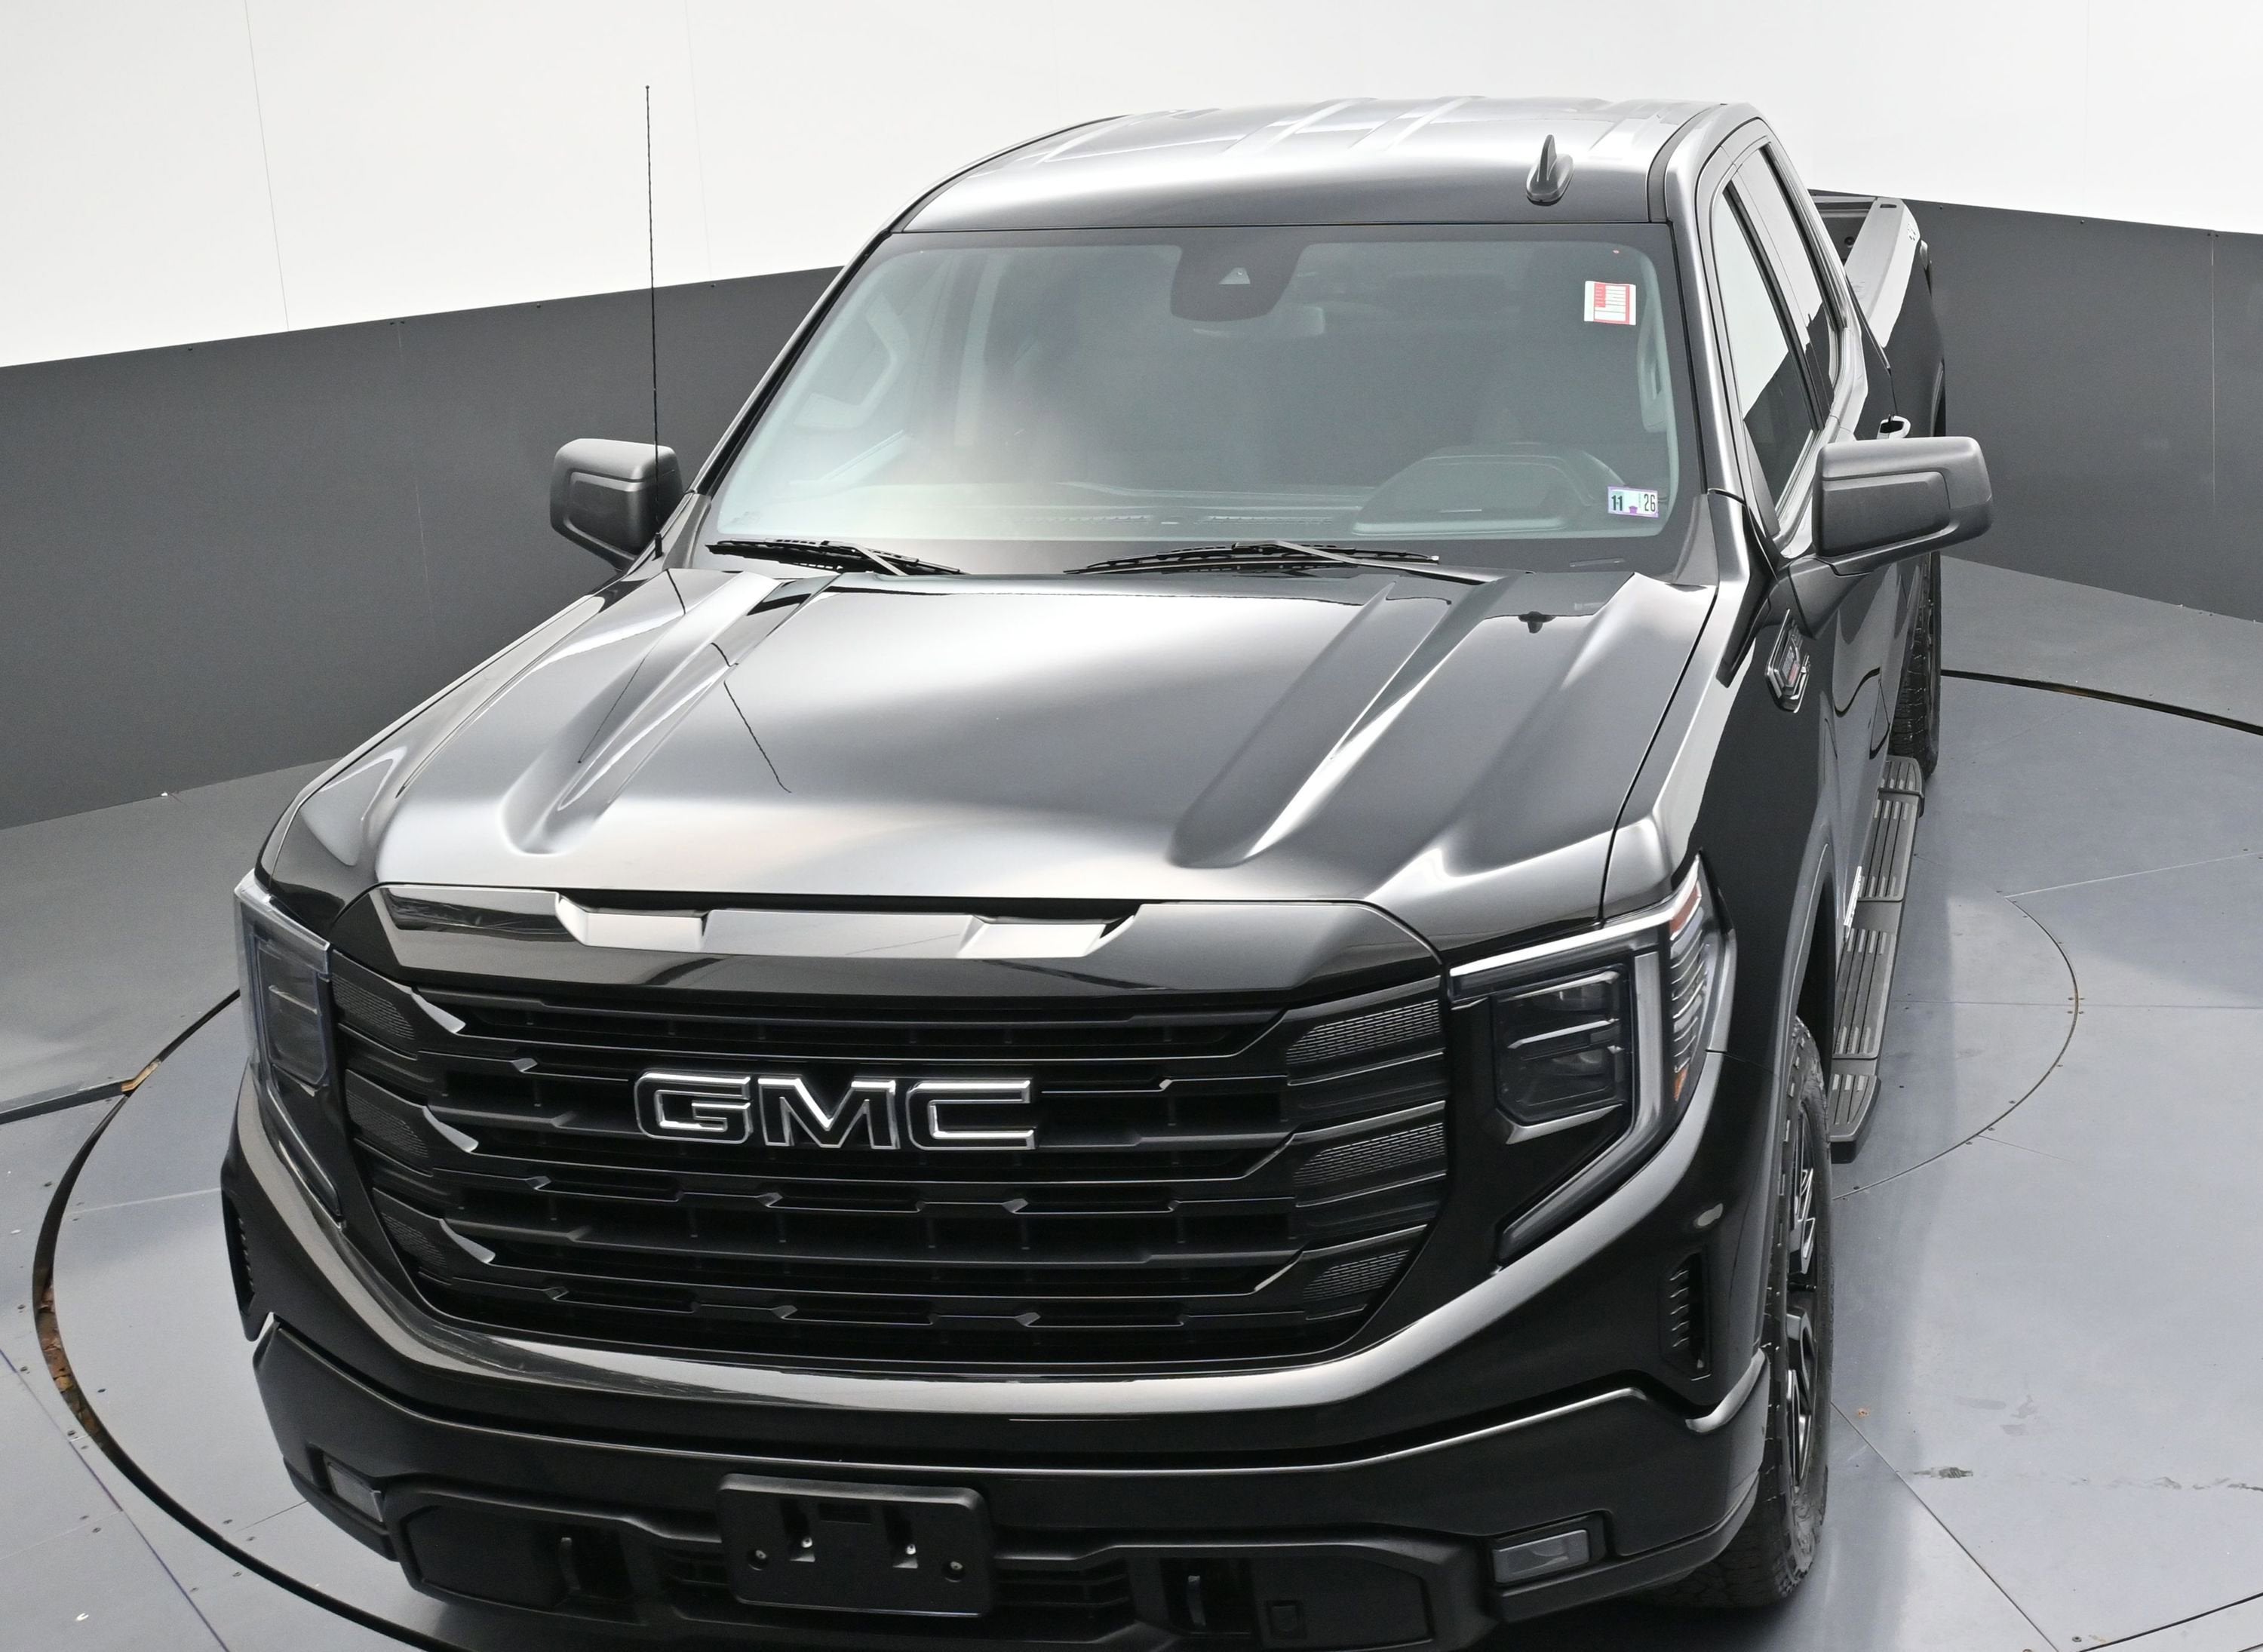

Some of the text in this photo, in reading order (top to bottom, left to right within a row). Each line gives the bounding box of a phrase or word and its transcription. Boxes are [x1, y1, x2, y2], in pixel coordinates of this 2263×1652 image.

[1611, 495, 1623, 511] 11
[1644, 493, 1656, 511] 26
[634, 1068, 1036, 1150] GMC
